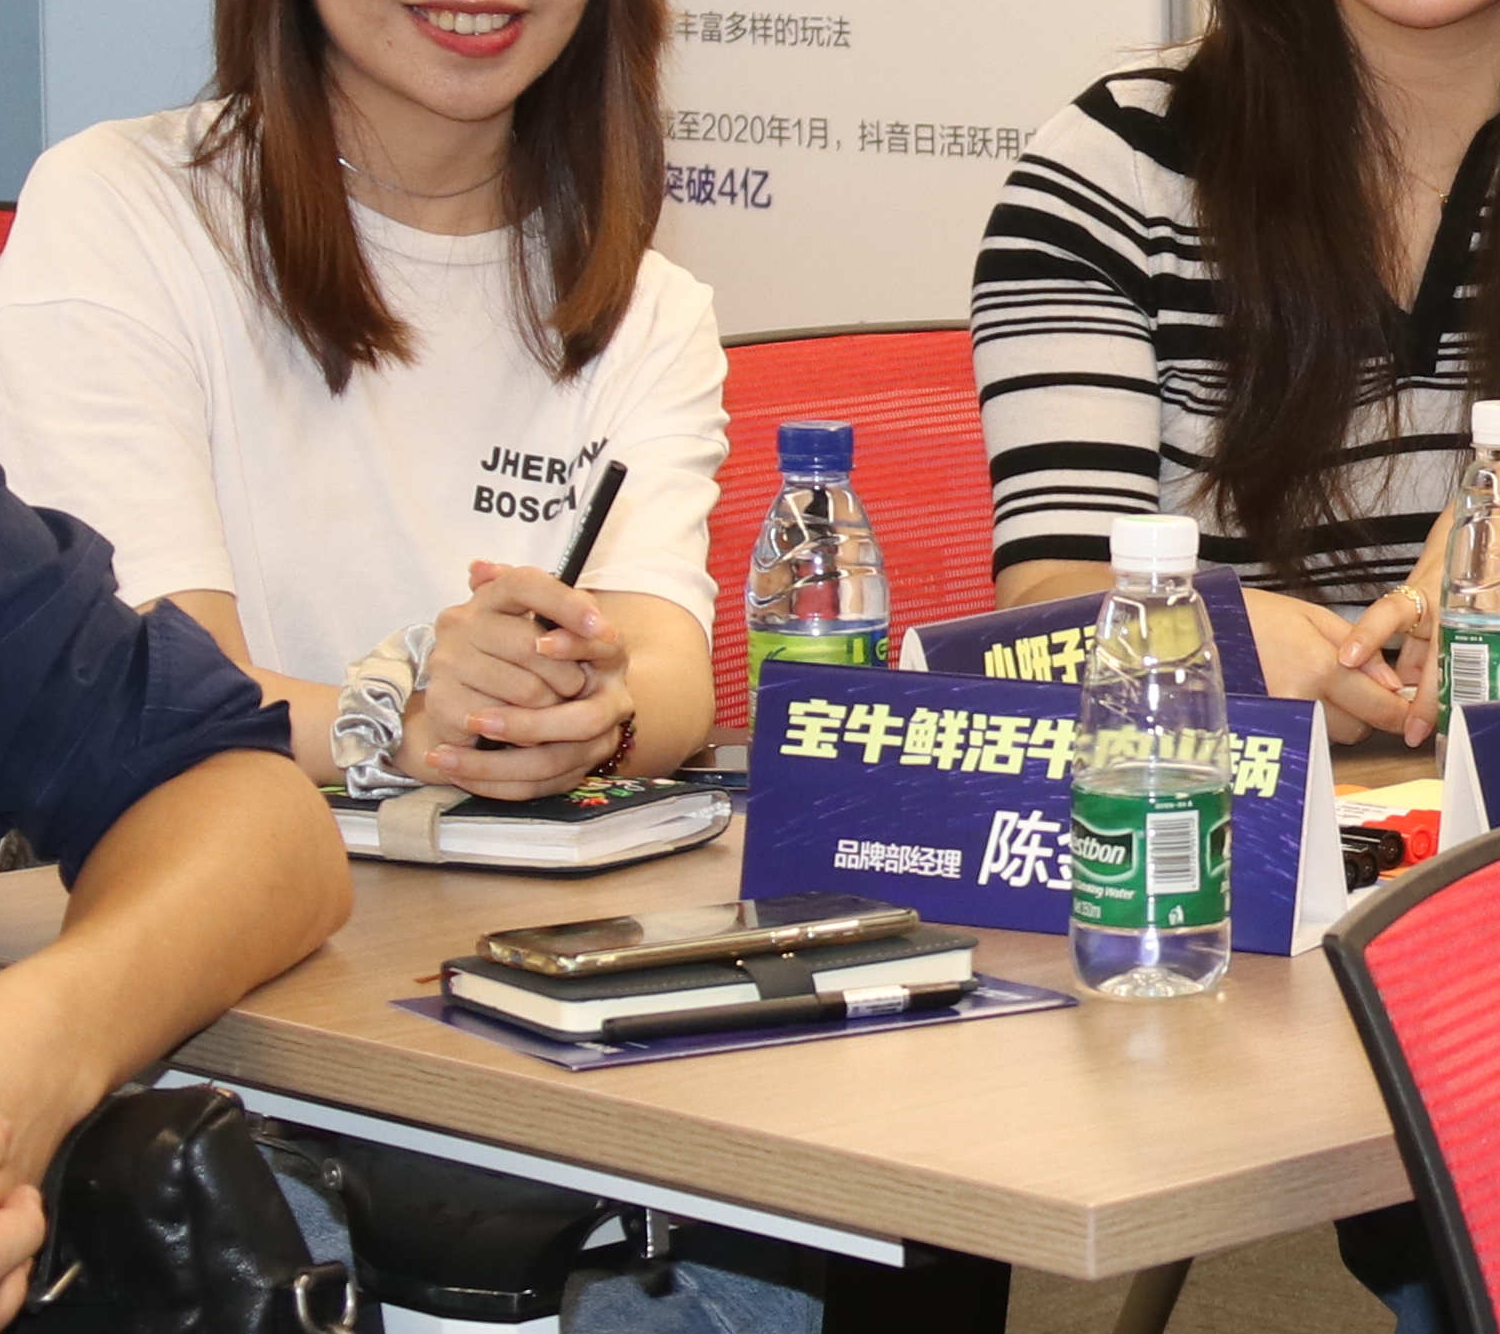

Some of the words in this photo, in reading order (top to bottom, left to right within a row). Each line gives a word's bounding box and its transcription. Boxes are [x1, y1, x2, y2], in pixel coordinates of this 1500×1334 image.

[675, 10, 852, 49] 丰富多样的玩法
[473, 485, 577, 523] BOSCH
[833, 839, 963, 880] 品牌部经理
